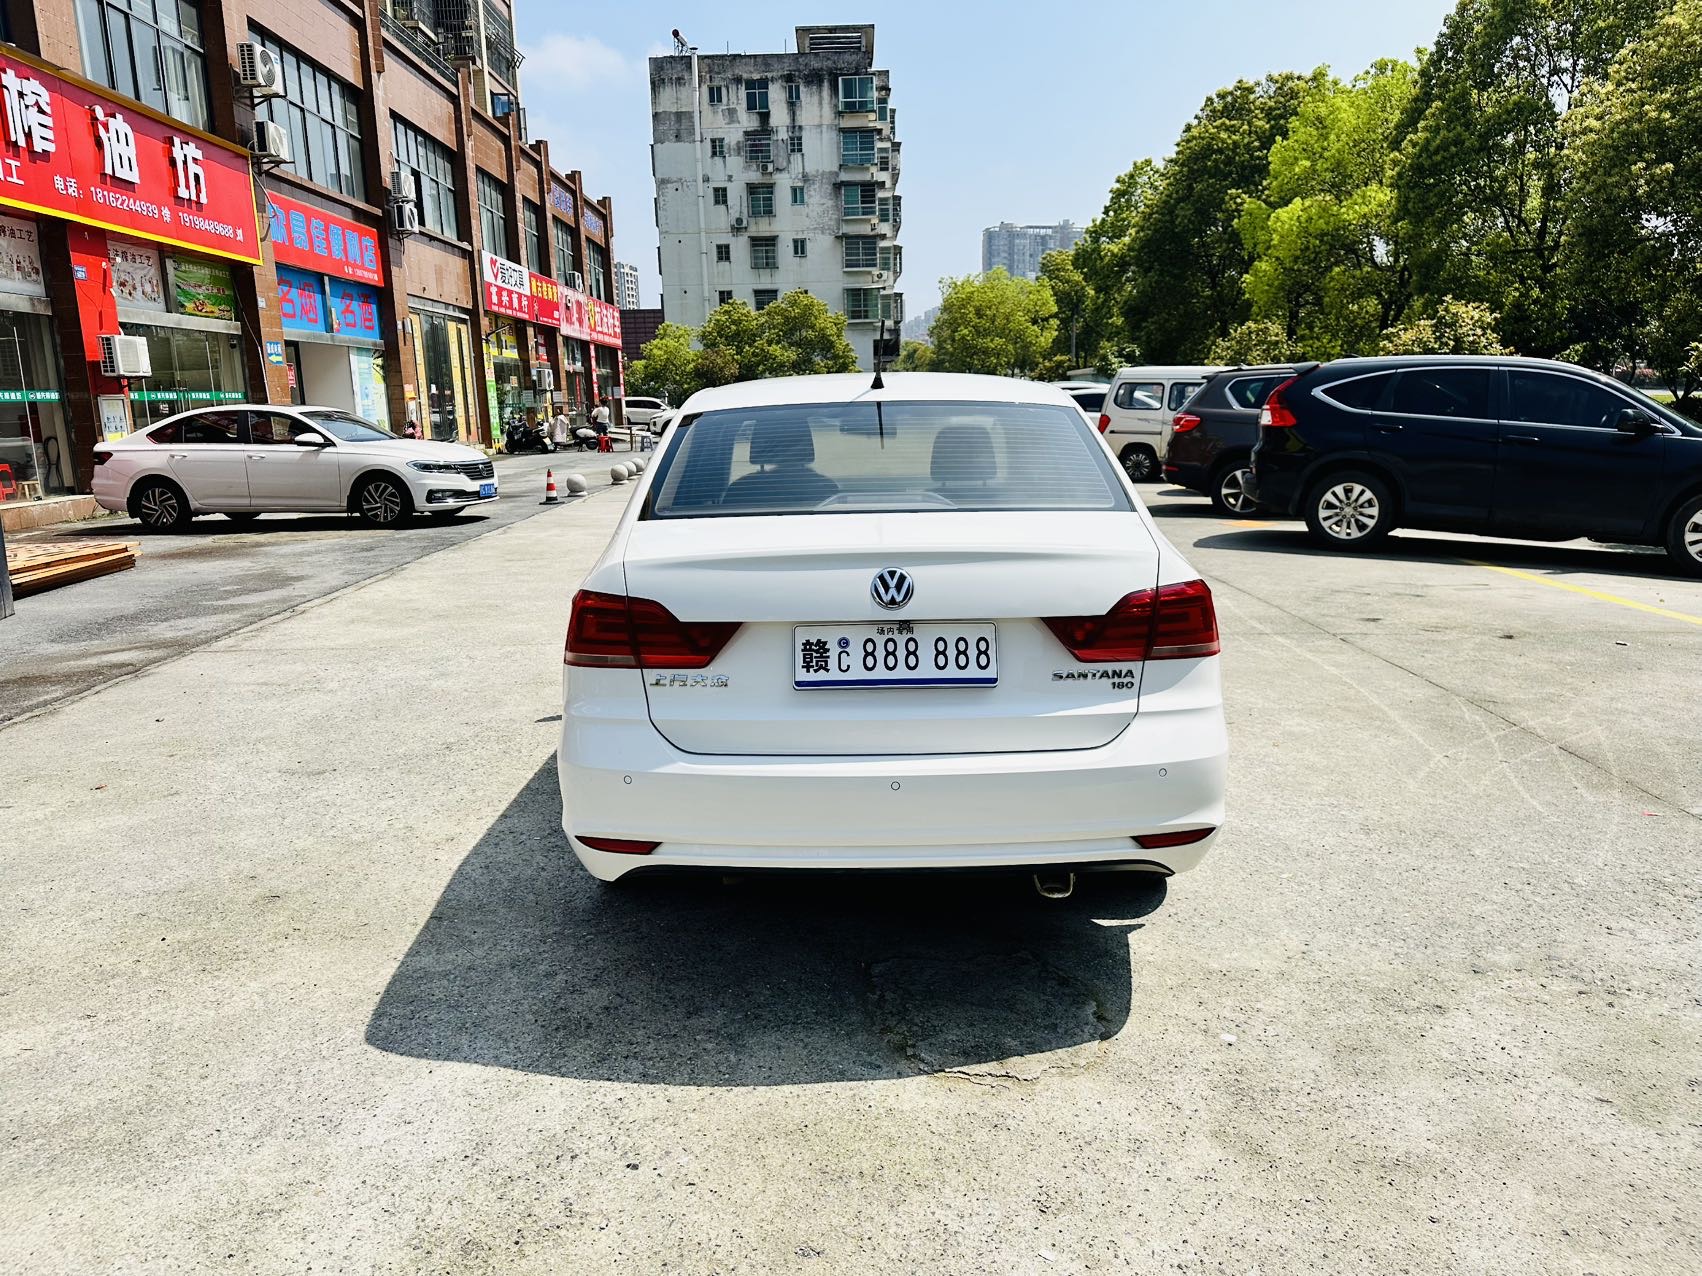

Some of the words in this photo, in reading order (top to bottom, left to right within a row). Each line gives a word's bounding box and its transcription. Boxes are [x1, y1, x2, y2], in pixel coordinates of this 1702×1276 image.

[1, 67, 208, 204] 榨油坊
[90, 186, 158, 219] 18162244939
[179, 212, 234, 239] 19198489688
[341, 289, 375, 331] 名酒
[876, 626, 914, 635] 场内专用
[649, 673, 730, 687] 上汽大众
[1051, 669, 1135, 681] SANTANA
[1112, 680, 1135, 689] 180
